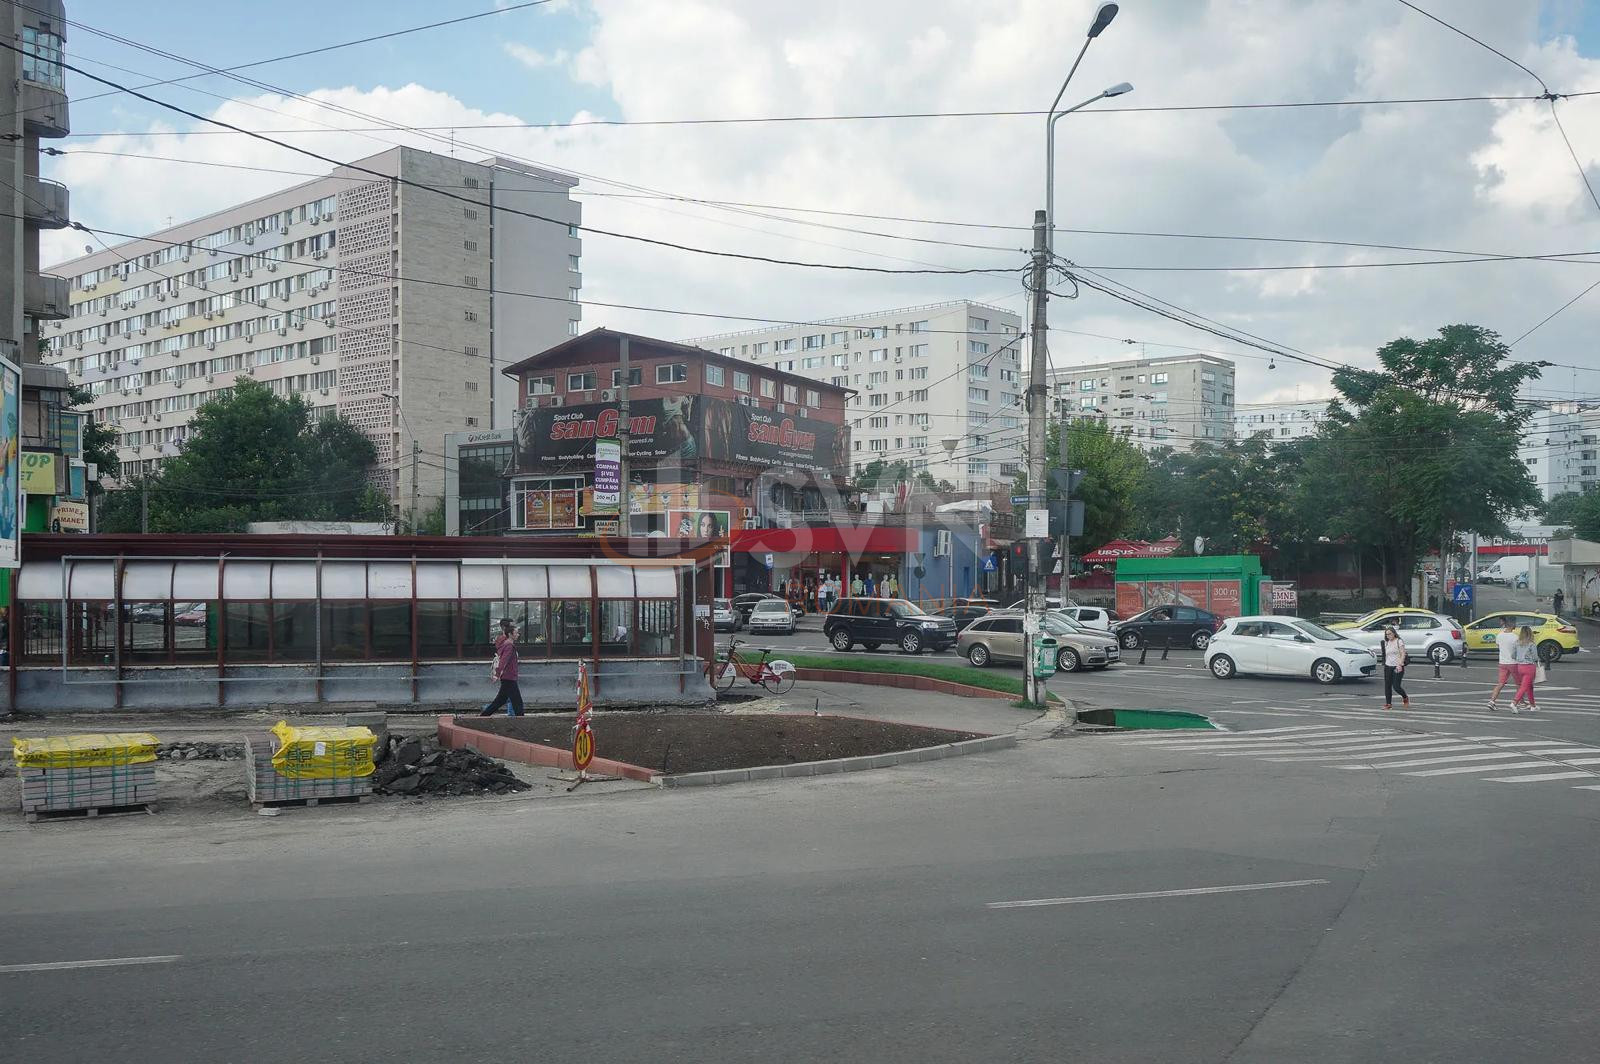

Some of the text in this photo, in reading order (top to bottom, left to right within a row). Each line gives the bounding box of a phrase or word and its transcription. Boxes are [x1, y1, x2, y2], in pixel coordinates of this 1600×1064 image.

[751, 413, 772, 423] Sport Club
[550, 408, 656, 440] sanGm
[56, 516, 85, 525] AMANET
[1097, 548, 1134, 556] URSUS
[1213, 588, 1228, 596] 300
[578, 734, 588, 761] 30
